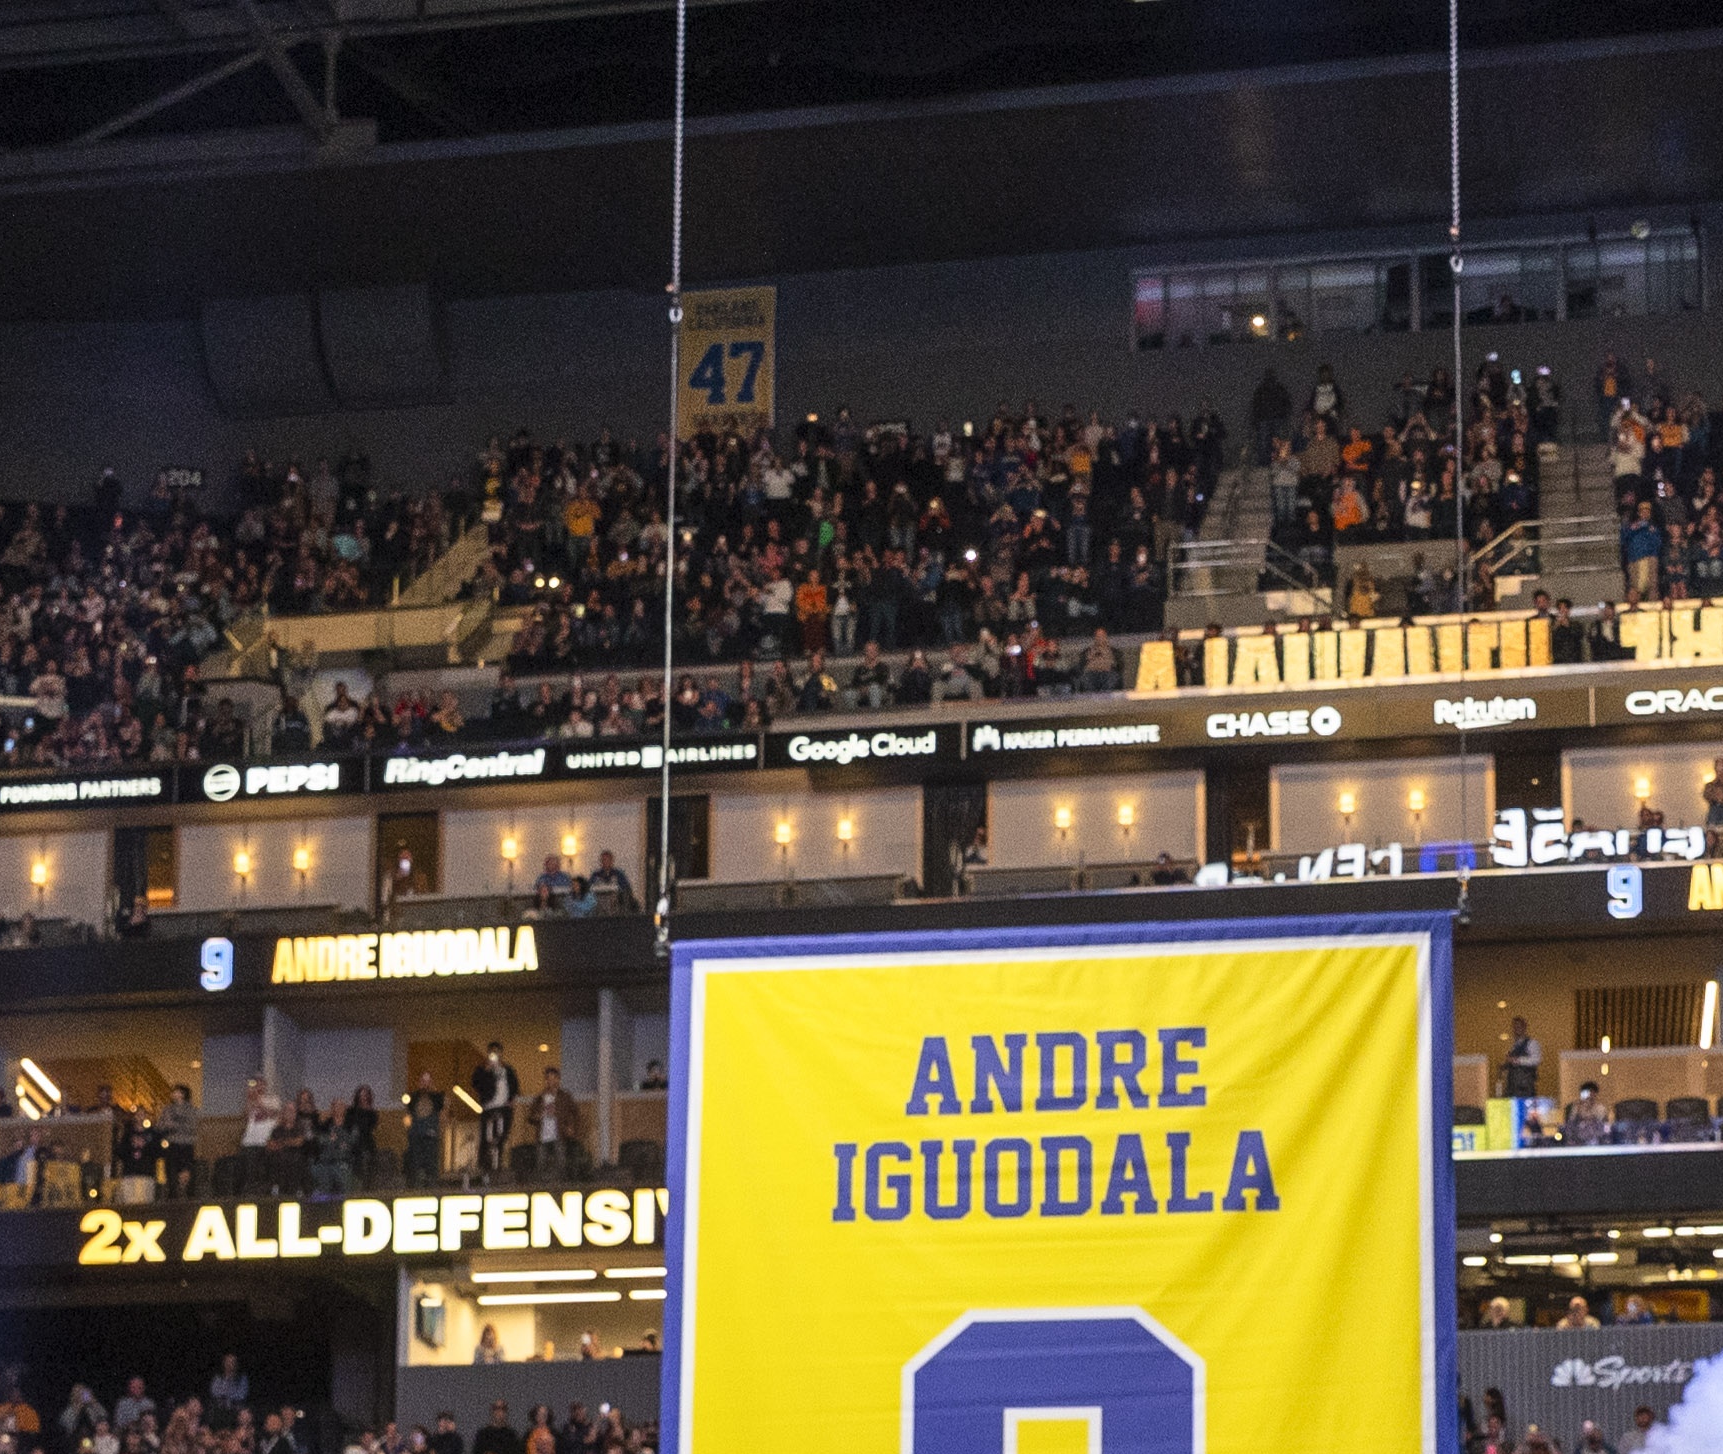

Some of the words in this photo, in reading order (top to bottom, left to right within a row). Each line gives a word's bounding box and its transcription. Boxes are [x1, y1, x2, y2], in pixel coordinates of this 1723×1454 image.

[688, 340, 766, 405] 47
[1206, 709, 1310, 738] CHASE
[1433, 696, 1537, 726] Rakuten
[566, 751, 641, 769] UNITED
[665, 744, 757, 763] AIRLINES
[788, 733, 870, 765] Google
[870, 730, 937, 757] Cloud
[245, 763, 340, 794] PEPSI
[383, 748, 546, 785] RingCentral
[0, 783, 78, 804] FOUNDING
[79, 777, 162, 799] PARTNERS
[1606, 863, 1644, 919] 9
[199, 936, 234, 992] 9
[271, 934, 378, 984] ANDRE
[378, 925, 539, 979] IGUODALA
[905, 1027, 1208, 1117] ANDRE
[831, 1129, 1281, 1223] IGUODALA
[78, 1208, 167, 1265] 2x
